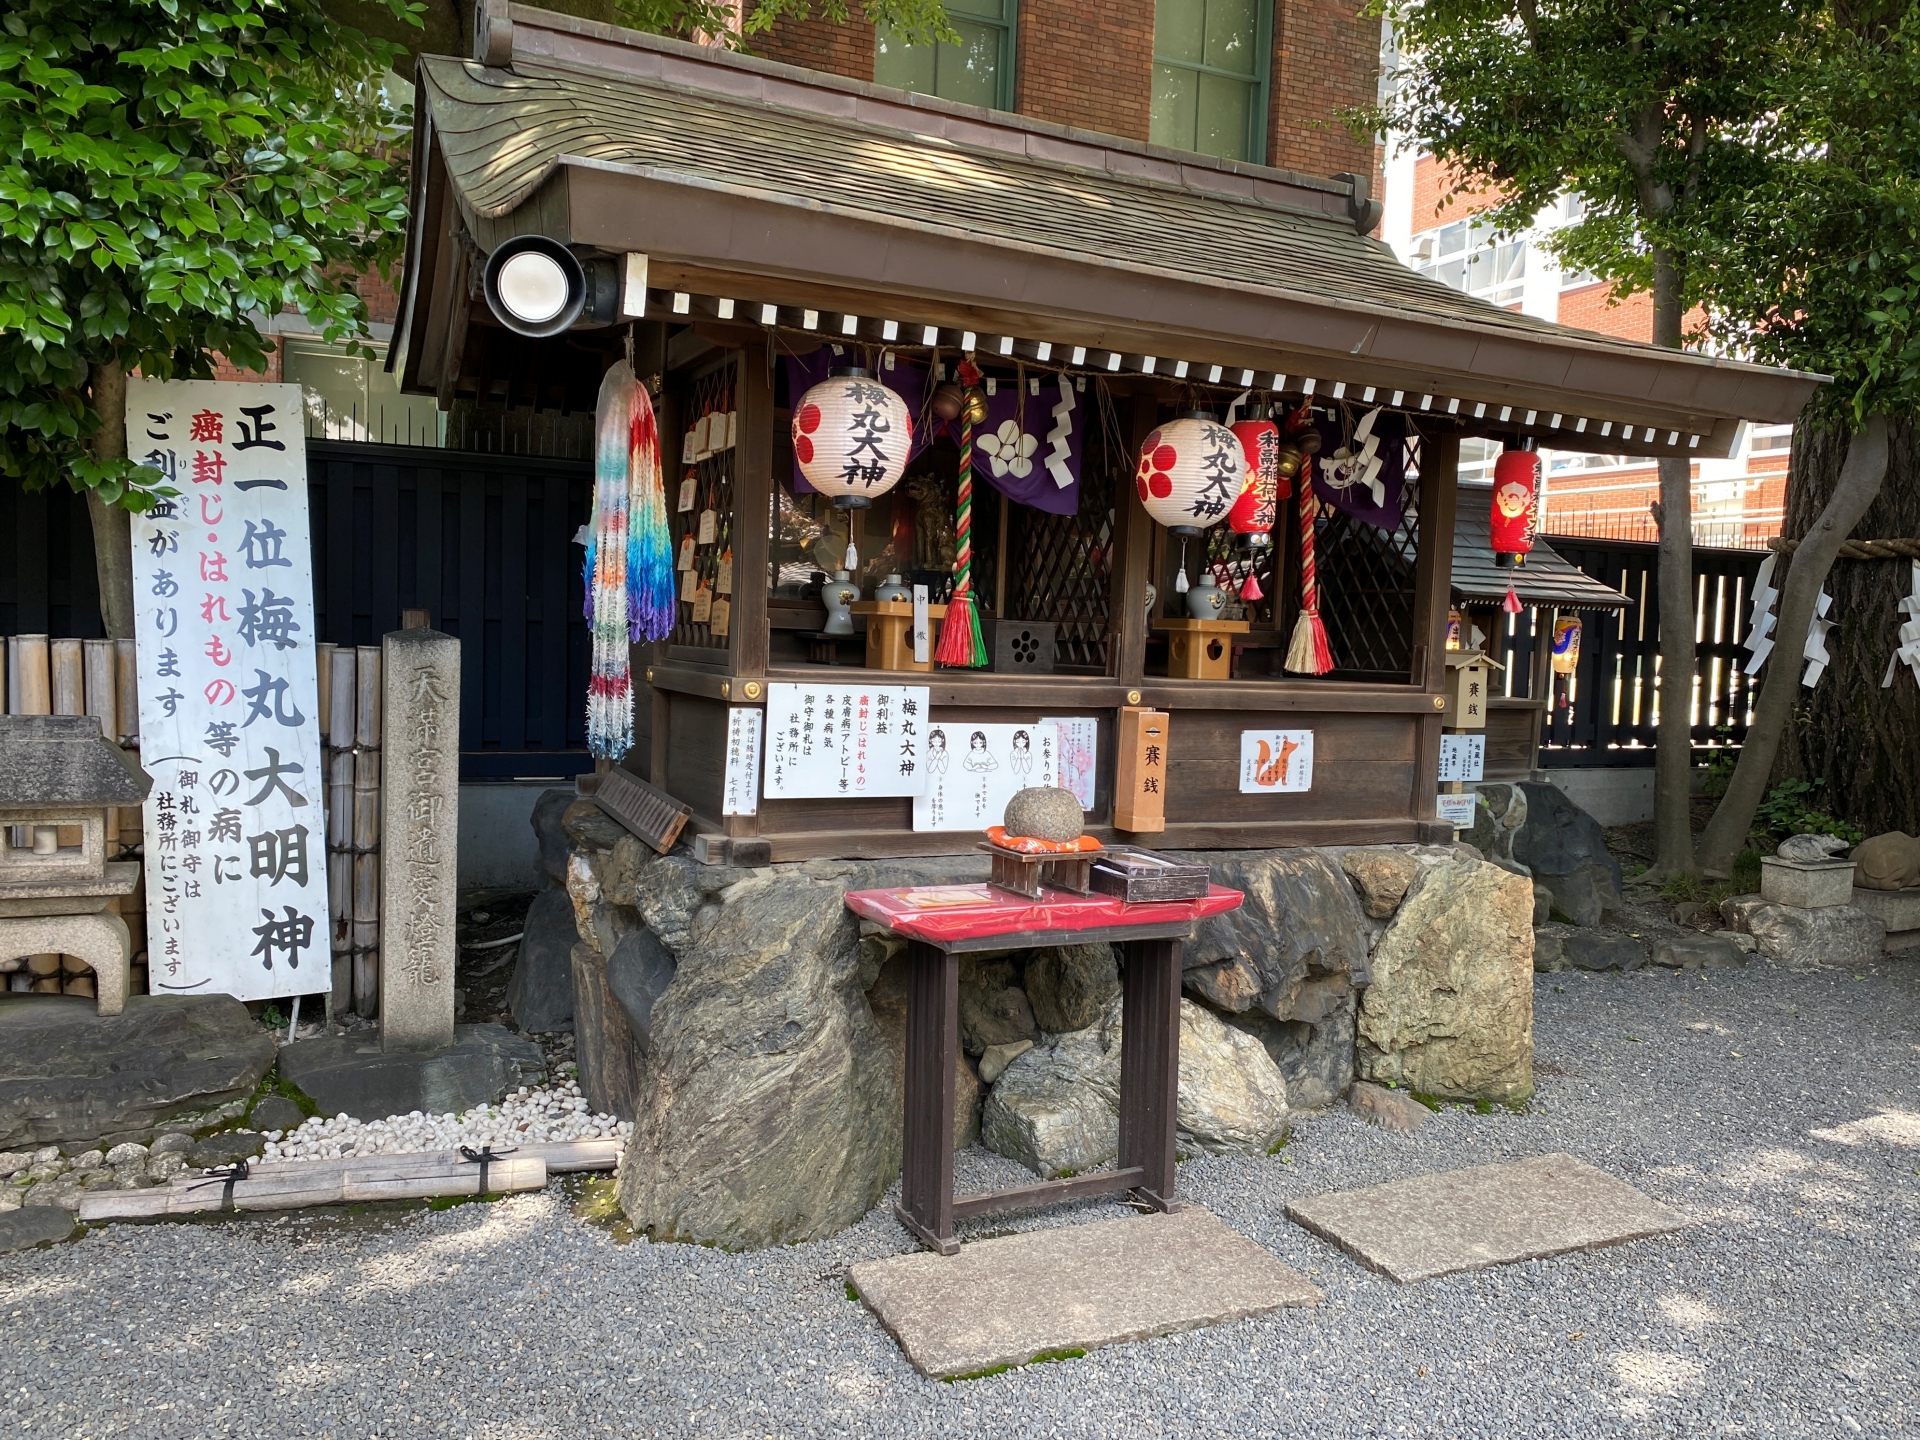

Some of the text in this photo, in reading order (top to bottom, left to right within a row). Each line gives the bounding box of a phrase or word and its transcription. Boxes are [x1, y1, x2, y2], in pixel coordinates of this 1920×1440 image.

[834, 381, 892, 489] 梅丸大神
[1181, 424, 1238, 520] 梅丸大神
[189, 408, 243, 885] 癌封じ・はれもの等の病に
[231, 403, 314, 971] 正一位梅丸大明神
[875, 694, 890, 735] 御利益
[1467, 682, 1480, 716] 賽銭
[788, 713, 800, 767] 社務所に
[802, 694, 815, 756] 御守・御札は
[823, 694, 835, 749] 各種病気
[855, 694, 869, 791] 癌封じ(はれもの)
[898, 698, 918, 777] 梅丸大神
[728, 777, 738, 806] 七千円
[774, 731, 786, 791] ございます。
[1143, 745, 1160, 795] 賽銭
